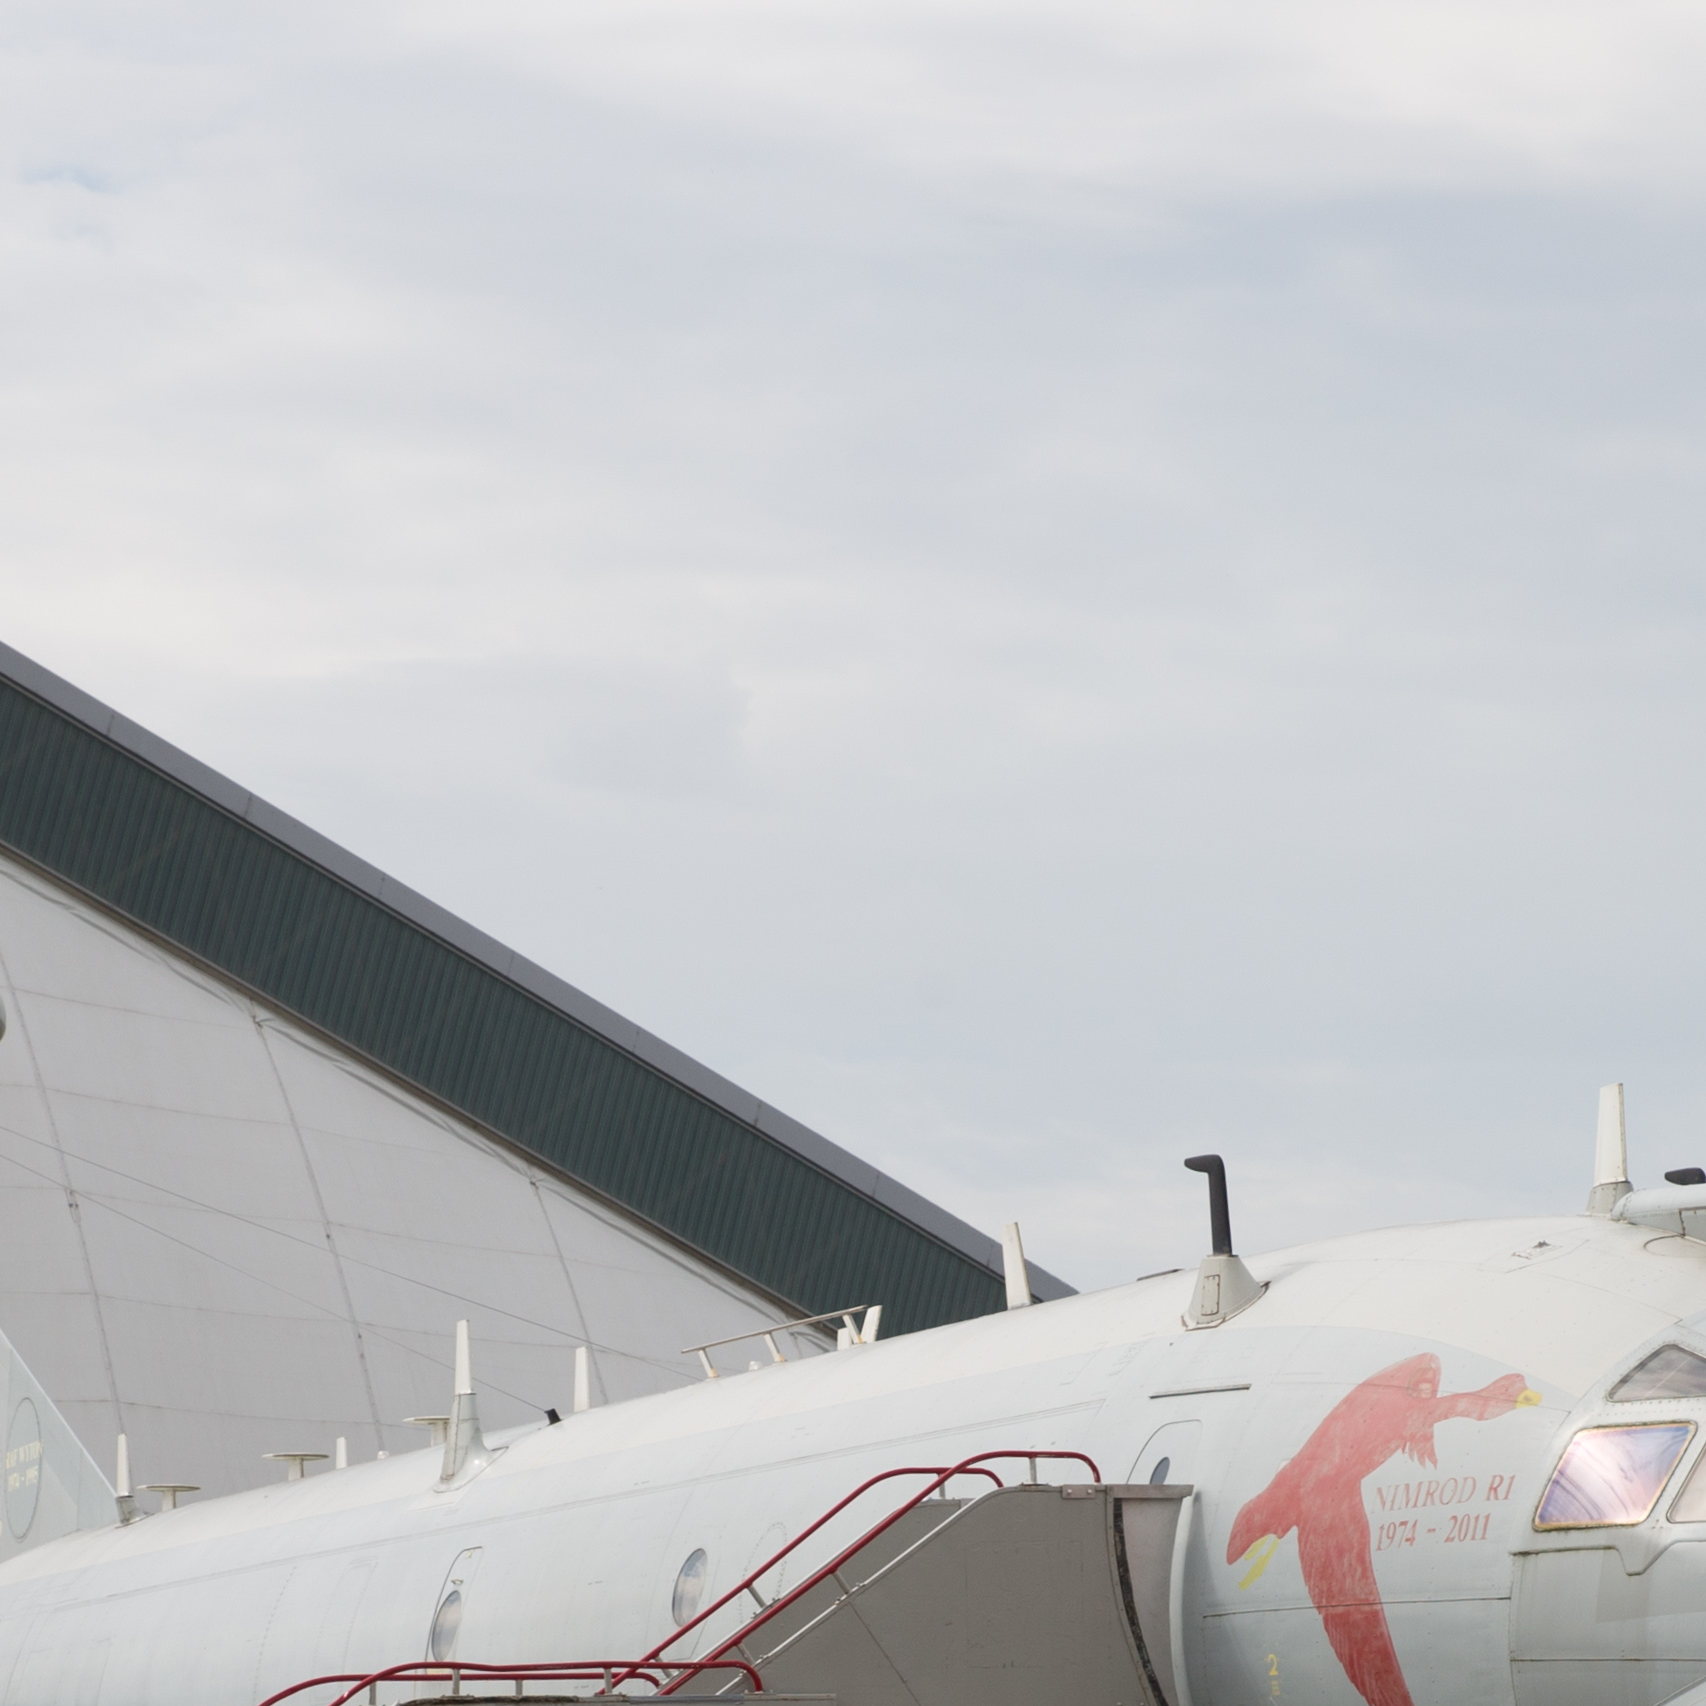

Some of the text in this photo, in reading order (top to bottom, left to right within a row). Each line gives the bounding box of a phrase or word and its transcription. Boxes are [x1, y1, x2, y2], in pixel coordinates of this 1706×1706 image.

[1370, 1474, 1517, 1514] NIMROD R1
[1376, 1519, 1416, 1551] 1974
[1444, 1513, 1489, 1543] 2011
[1267, 1653, 1280, 1676] 2
